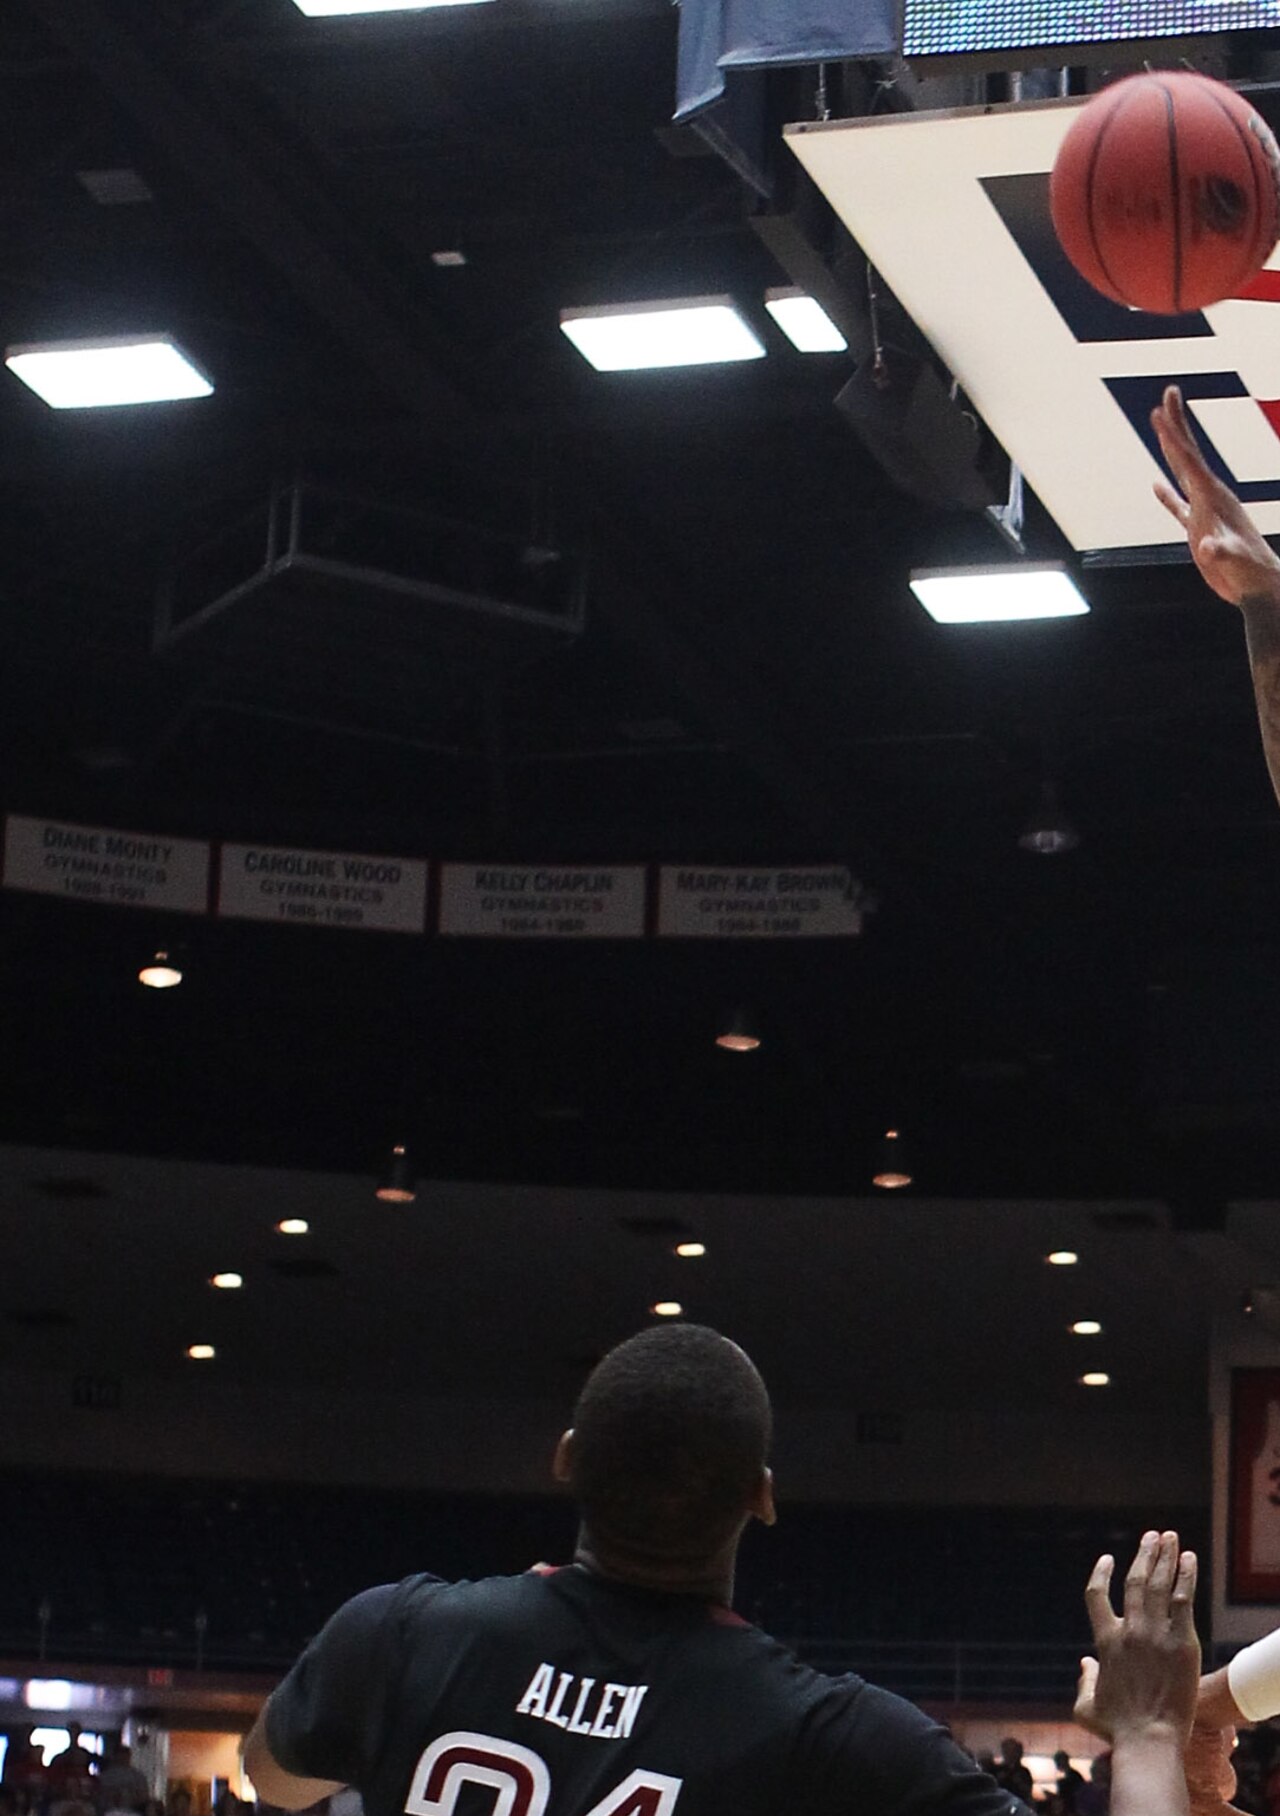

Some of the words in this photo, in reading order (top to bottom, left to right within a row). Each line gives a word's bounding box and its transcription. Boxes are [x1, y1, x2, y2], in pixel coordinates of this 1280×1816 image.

[244, 850, 336, 879] CAROLINE
[342, 859, 402, 884] WOOD
[516, 1662, 649, 1739] ALLEN
